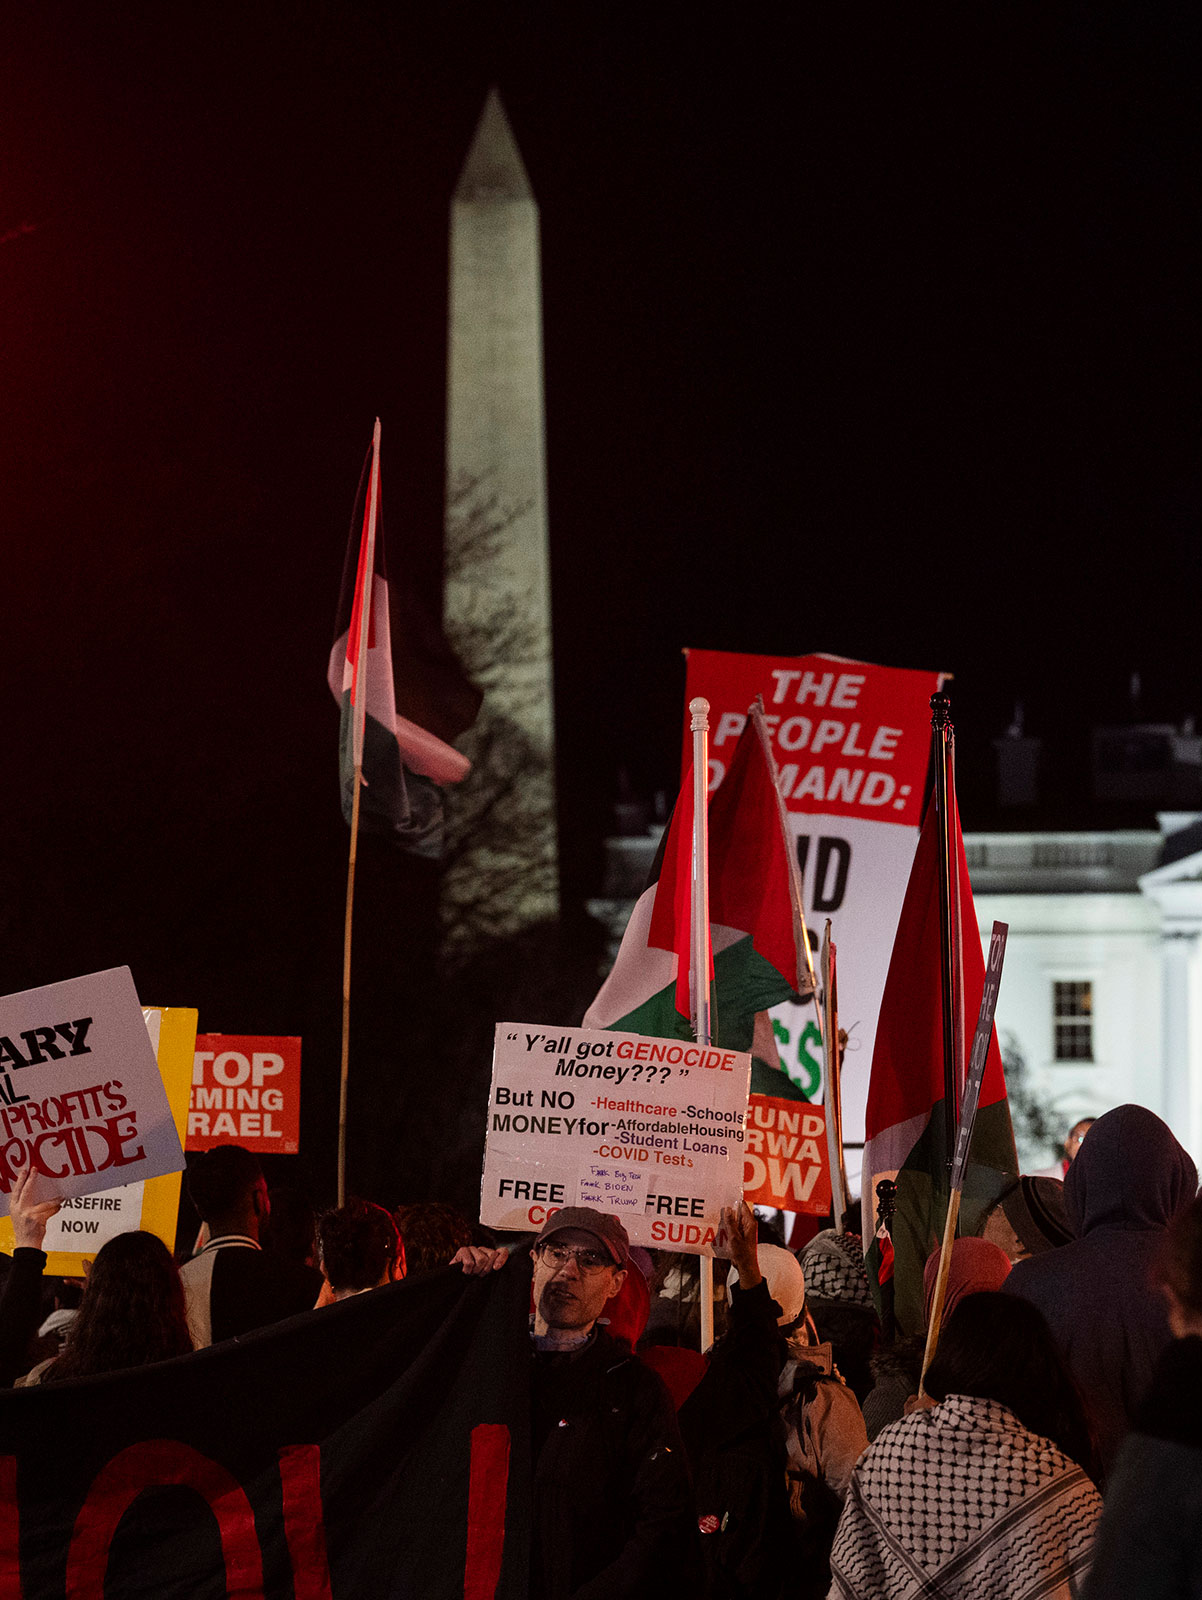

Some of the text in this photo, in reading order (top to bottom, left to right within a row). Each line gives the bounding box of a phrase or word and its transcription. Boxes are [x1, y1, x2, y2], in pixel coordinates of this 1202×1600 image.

[771, 669, 866, 709] THE
[192, 1051, 285, 1087] TOP
[576, 1041, 614, 1060] got
[617, 1041, 736, 1072] GENOCIDE
[555, 1058, 671, 1085] Money???
[1, 1080, 127, 1138] PROFITS
[190, 1088, 284, 1111] MING
[495, 1087, 575, 1110] But NO
[591, 1097, 745, 1125] -Healthcare -Schools
[188, 1112, 283, 1138] RAEL
[593, 1145, 694, 1168] -COVID Tests
[614, 1132, 728, 1156] -Student Loans
[744, 1128, 822, 1164] RWA
[743, 1153, 822, 1202] OW
[499, 1179, 705, 1218] FREE FREE
[61, 1220, 99, 1234] NOW
